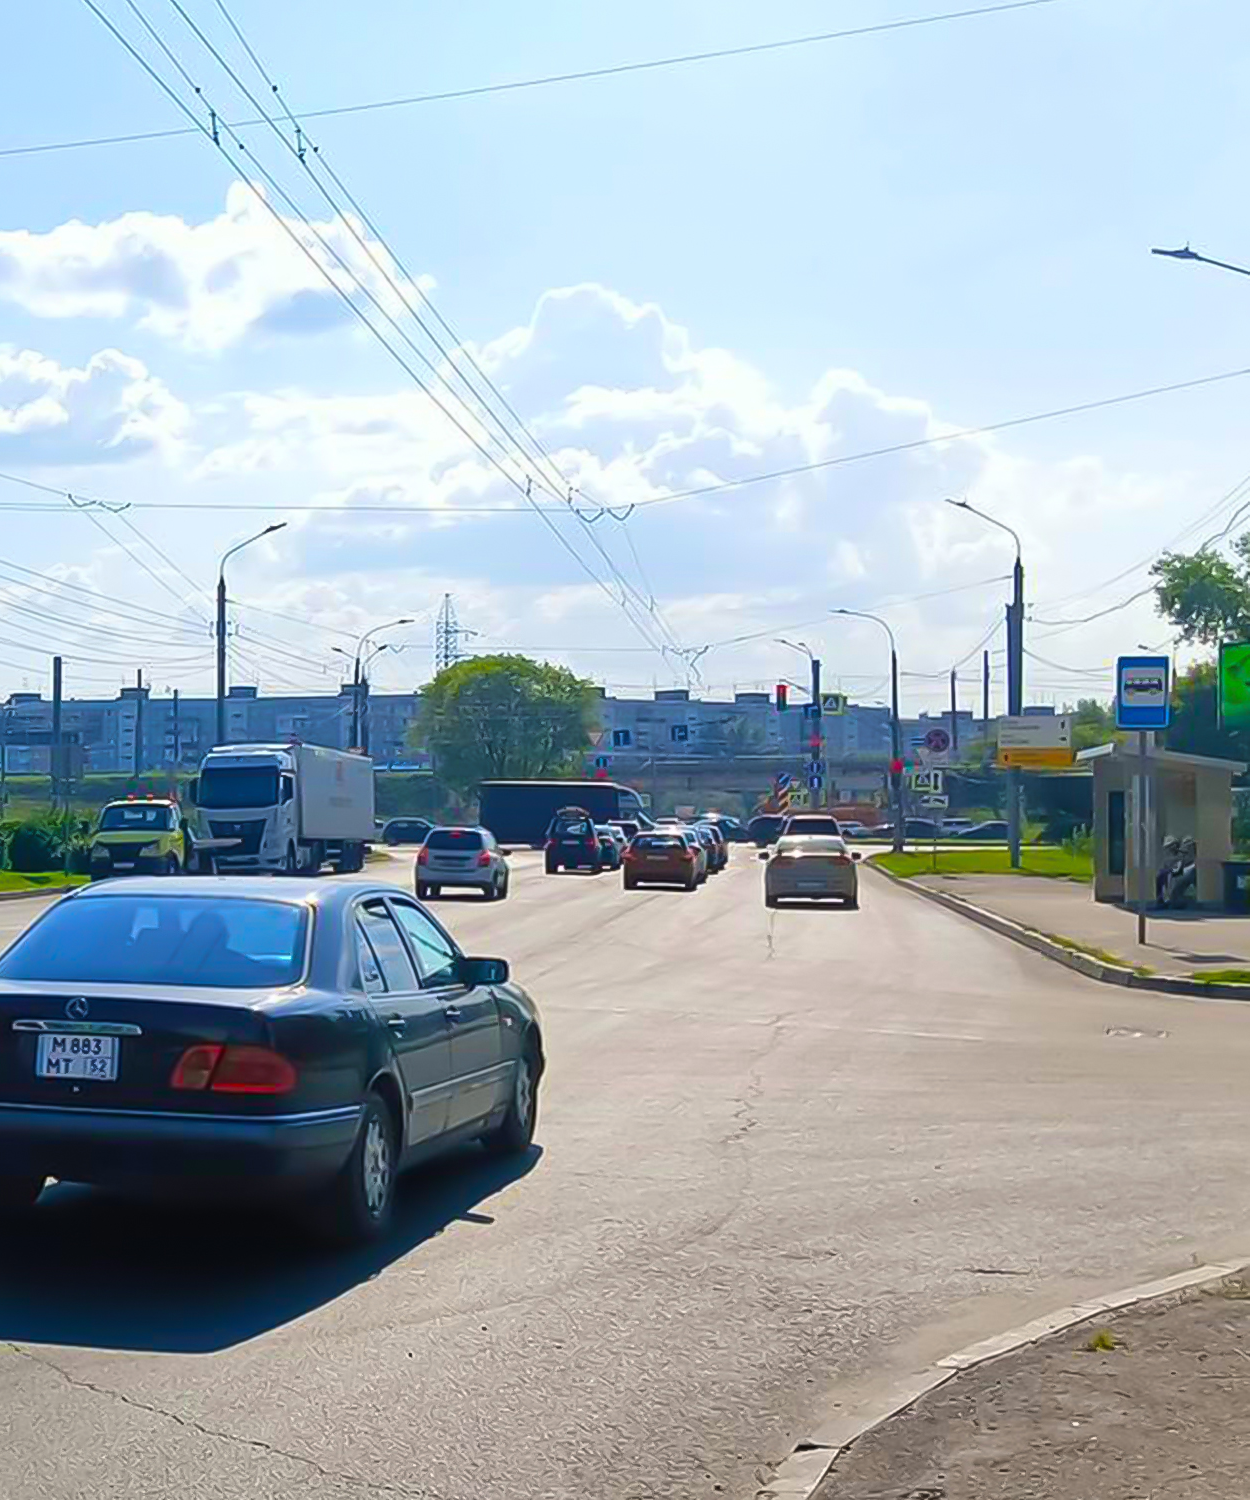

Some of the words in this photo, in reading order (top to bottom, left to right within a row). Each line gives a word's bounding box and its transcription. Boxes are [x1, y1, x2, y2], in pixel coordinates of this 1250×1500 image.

[70, 1038, 103, 1055] 883
[47, 1058, 73, 1074] МТ
[90, 1059, 108, 1073] 52
